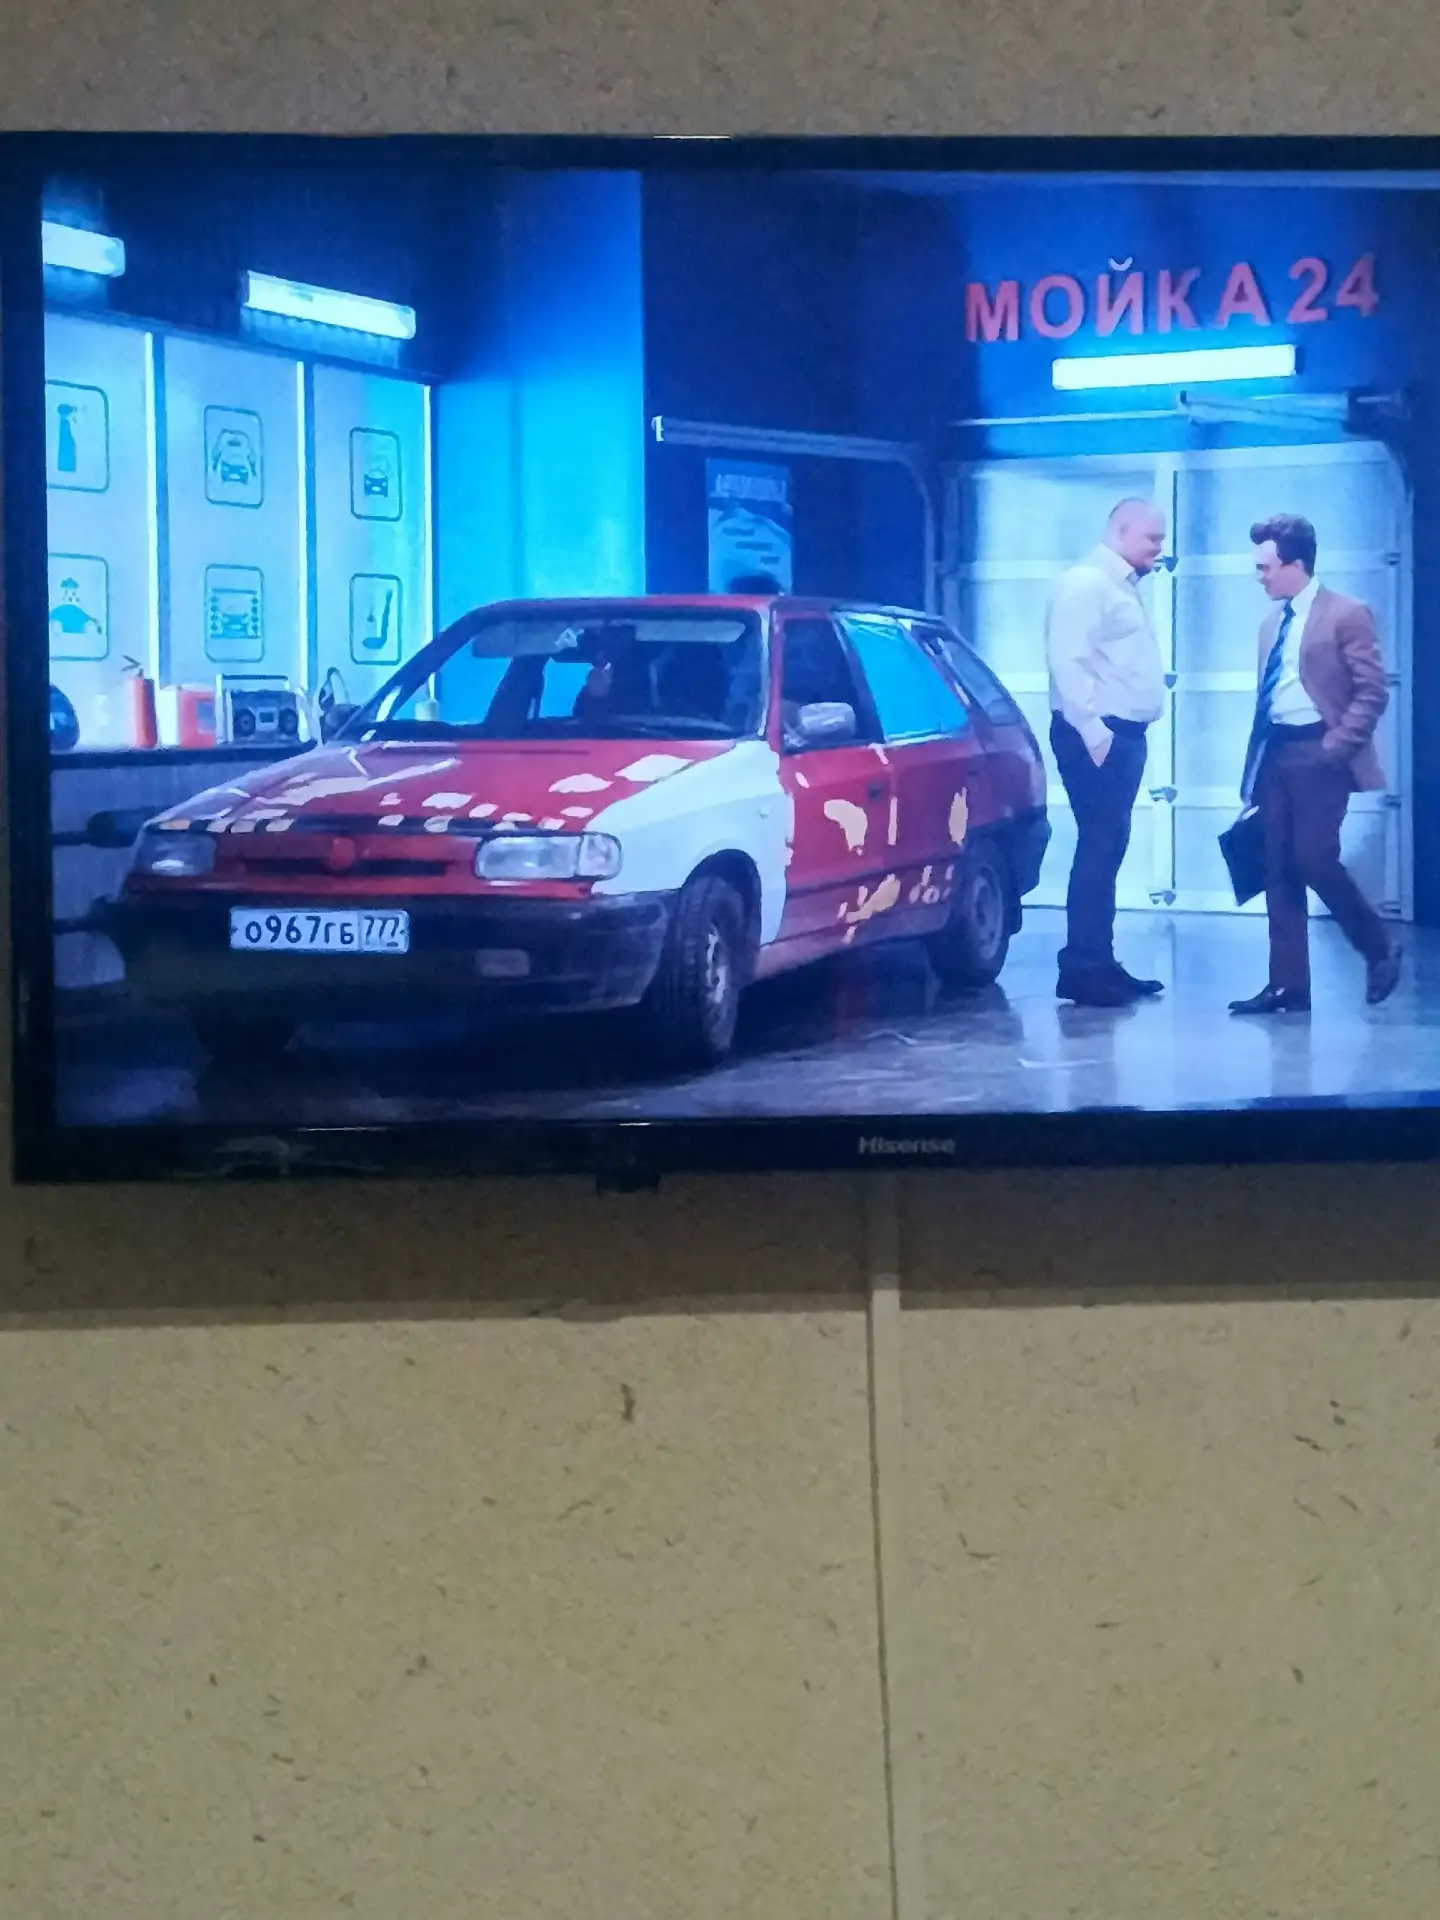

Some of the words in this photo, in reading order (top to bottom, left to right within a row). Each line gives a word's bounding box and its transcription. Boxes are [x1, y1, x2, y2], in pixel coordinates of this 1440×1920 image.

[965, 256, 1271, 343] МОЙКА
[1286, 253, 1380, 325] 24
[858, 1135, 956, 1155] Hisense
